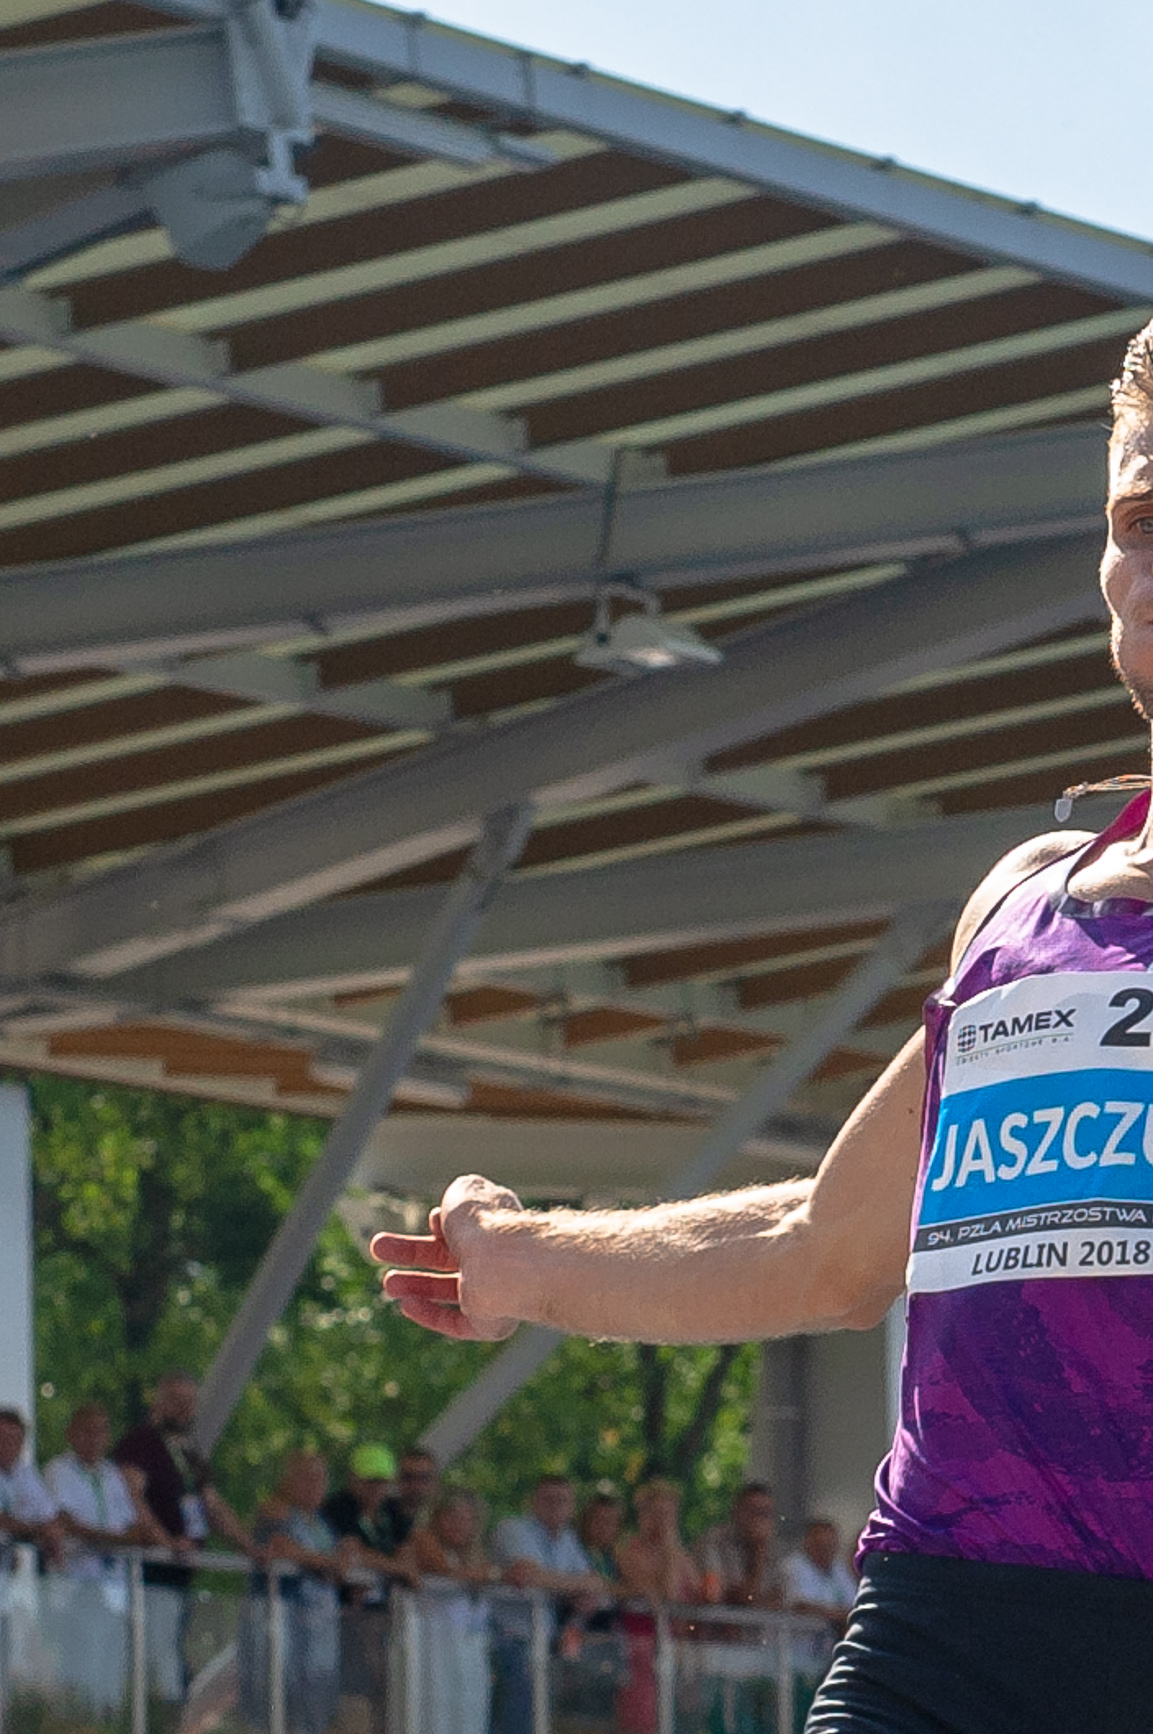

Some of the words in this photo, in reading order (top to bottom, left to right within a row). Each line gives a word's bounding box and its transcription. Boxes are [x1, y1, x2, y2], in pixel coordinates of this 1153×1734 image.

[978, 1008, 1077, 1043] TAMEX
[957, 1221, 1002, 1240] PZLA
[1005, 1207, 1147, 1231] MISTRZOSTWA
[971, 1241, 1069, 1276] LUBLIN
[1078, 1239, 1152, 1267] 2018
